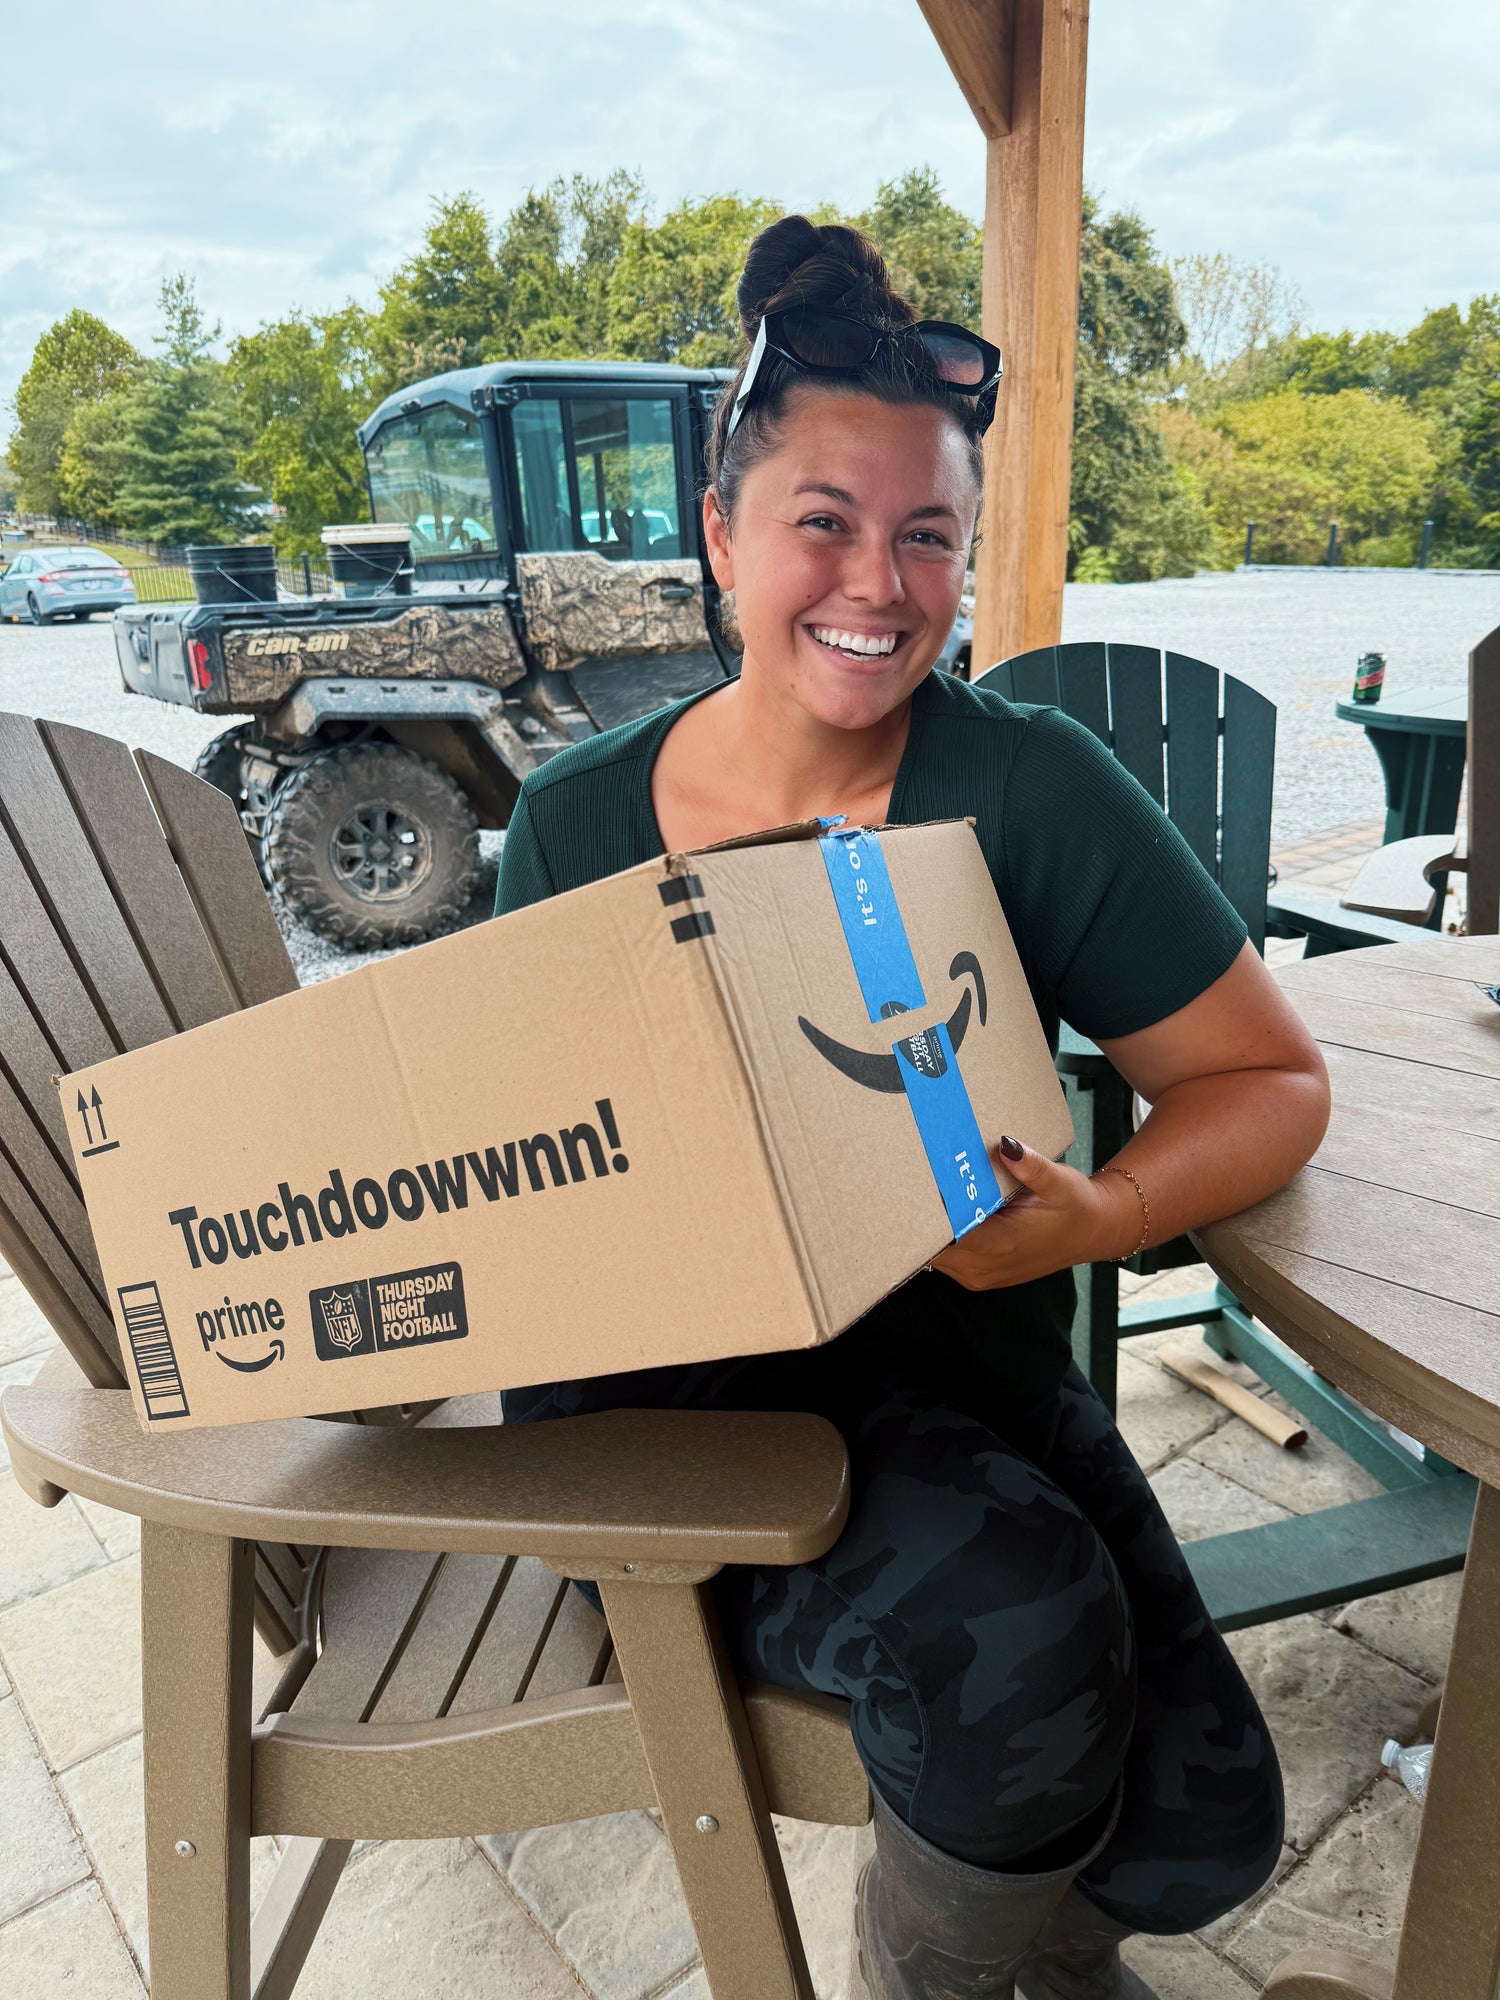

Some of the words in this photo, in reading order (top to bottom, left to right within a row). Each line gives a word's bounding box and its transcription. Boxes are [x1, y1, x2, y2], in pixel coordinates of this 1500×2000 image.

[247, 633, 350, 656] can-am
[856, 877, 878, 926] It's
[168, 1097, 630, 1269] Touchdoowwnn!
[954, 1150, 978, 1201] It's
[376, 1270, 455, 1304] THURSDAY
[195, 1295, 285, 1352] prime
[380, 1297, 426, 1323] NIGHT
[382, 1311, 458, 1343] FOOTBALL
[329, 1314, 360, 1343] NFL
